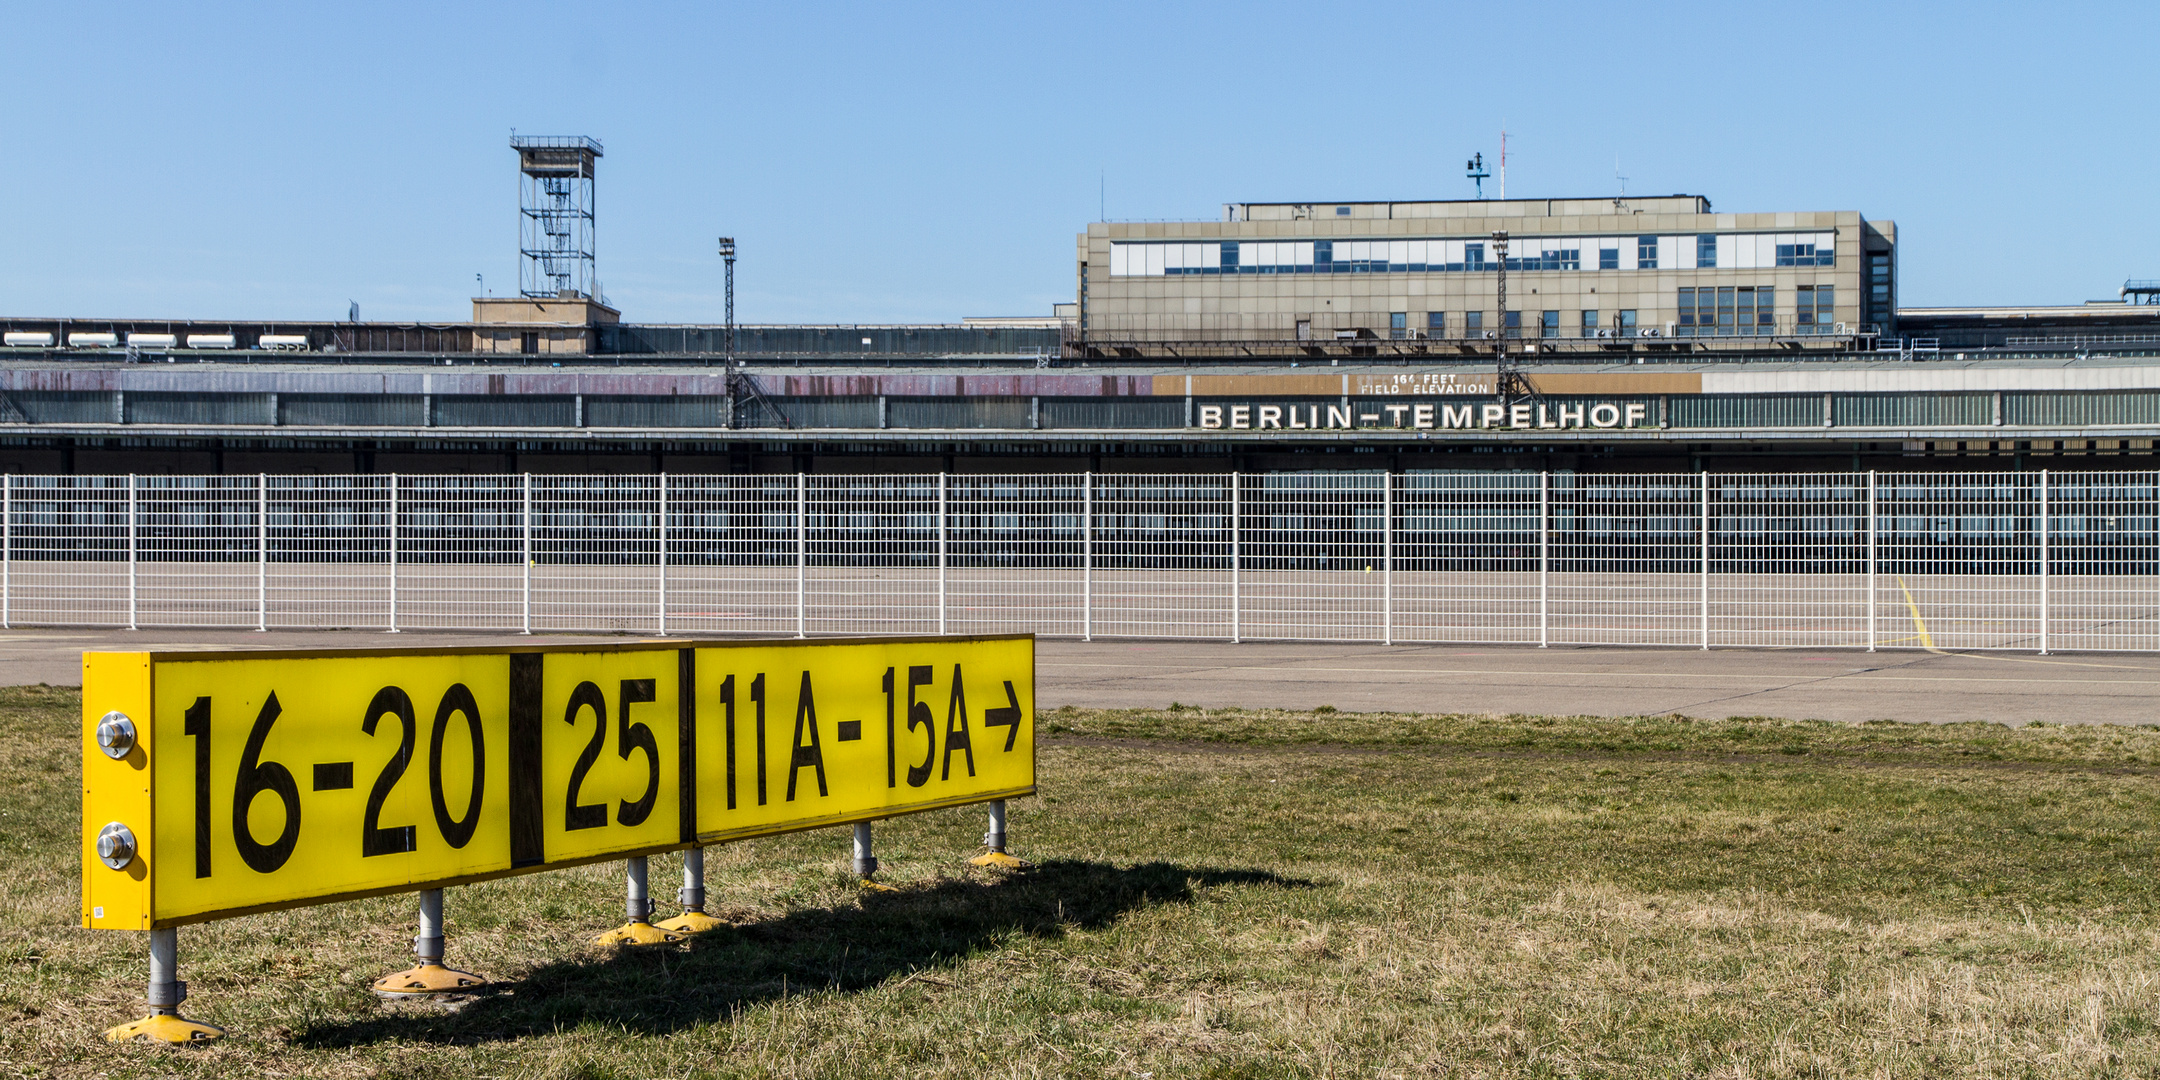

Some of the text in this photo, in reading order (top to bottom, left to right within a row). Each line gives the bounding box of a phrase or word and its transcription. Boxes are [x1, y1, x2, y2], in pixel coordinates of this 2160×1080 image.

[1361, 384, 1488, 395] FIELD ELEVATION
[1424, 374, 1456, 384] FEET
[1200, 404, 1646, 430] BERLIN-TEMPELHOF
[564, 678, 660, 831] 25
[184, 683, 486, 879] 16-20
